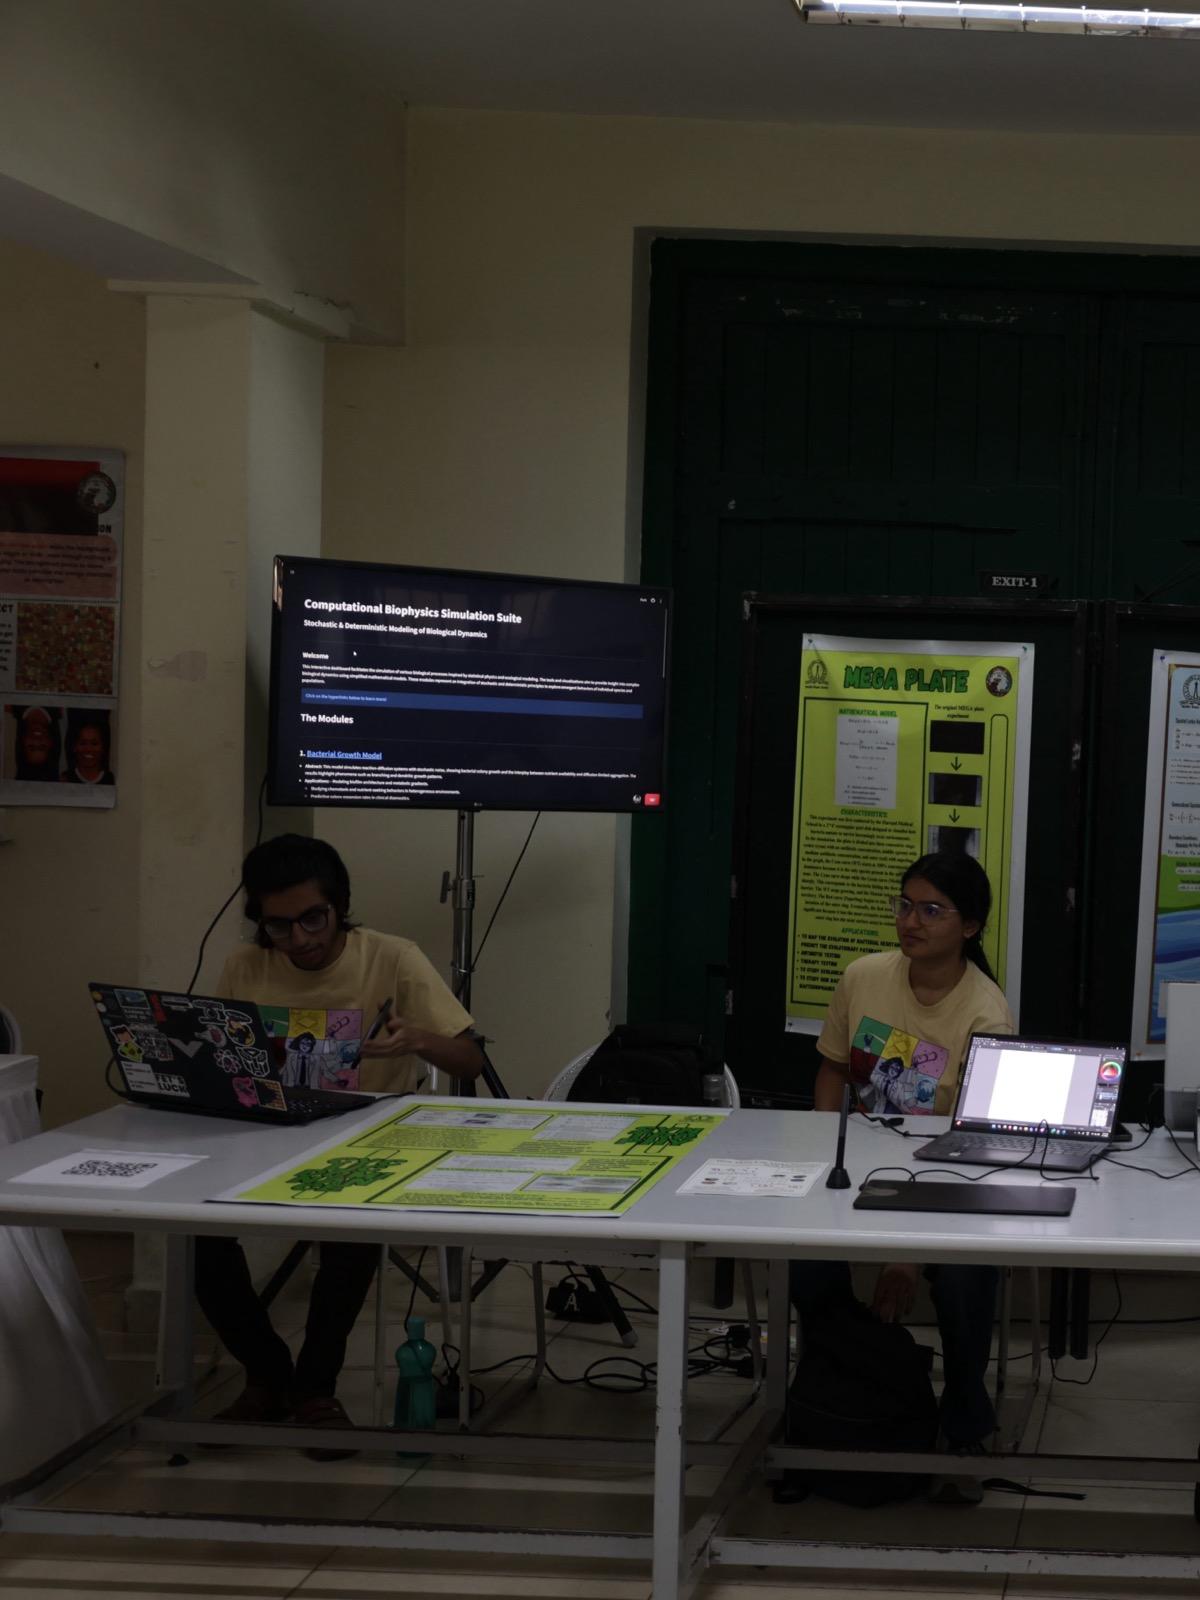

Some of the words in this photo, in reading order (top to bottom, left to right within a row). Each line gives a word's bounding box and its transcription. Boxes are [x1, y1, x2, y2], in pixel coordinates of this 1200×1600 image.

[992, 576, 1038, 588] EXIT-1
[303, 598, 383, 614] Computational
[384, 604, 439, 619] Biophysics
[440, 608, 494, 621] Simulation
[496, 612, 522, 623] Suite
[303, 619, 337, 628] Stochastic
[345, 622, 387, 631] Deterministic
[388, 625, 418, 635] Modeling
[426, 627, 456, 637] Biological
[457, 629, 487, 639] Dynamics
[302, 651, 329, 659] Welcome
[844, 665, 898, 690] MEGA
[904, 668, 969, 693] PLATE
[839, 708, 879, 716] MATHEMATICAL
[300, 713, 316, 722] The
[318, 713, 353, 724] Modules
[306, 749, 336, 757] Bacterial
[337, 750, 362, 758] Growth
[362, 751, 382, 759] Model
